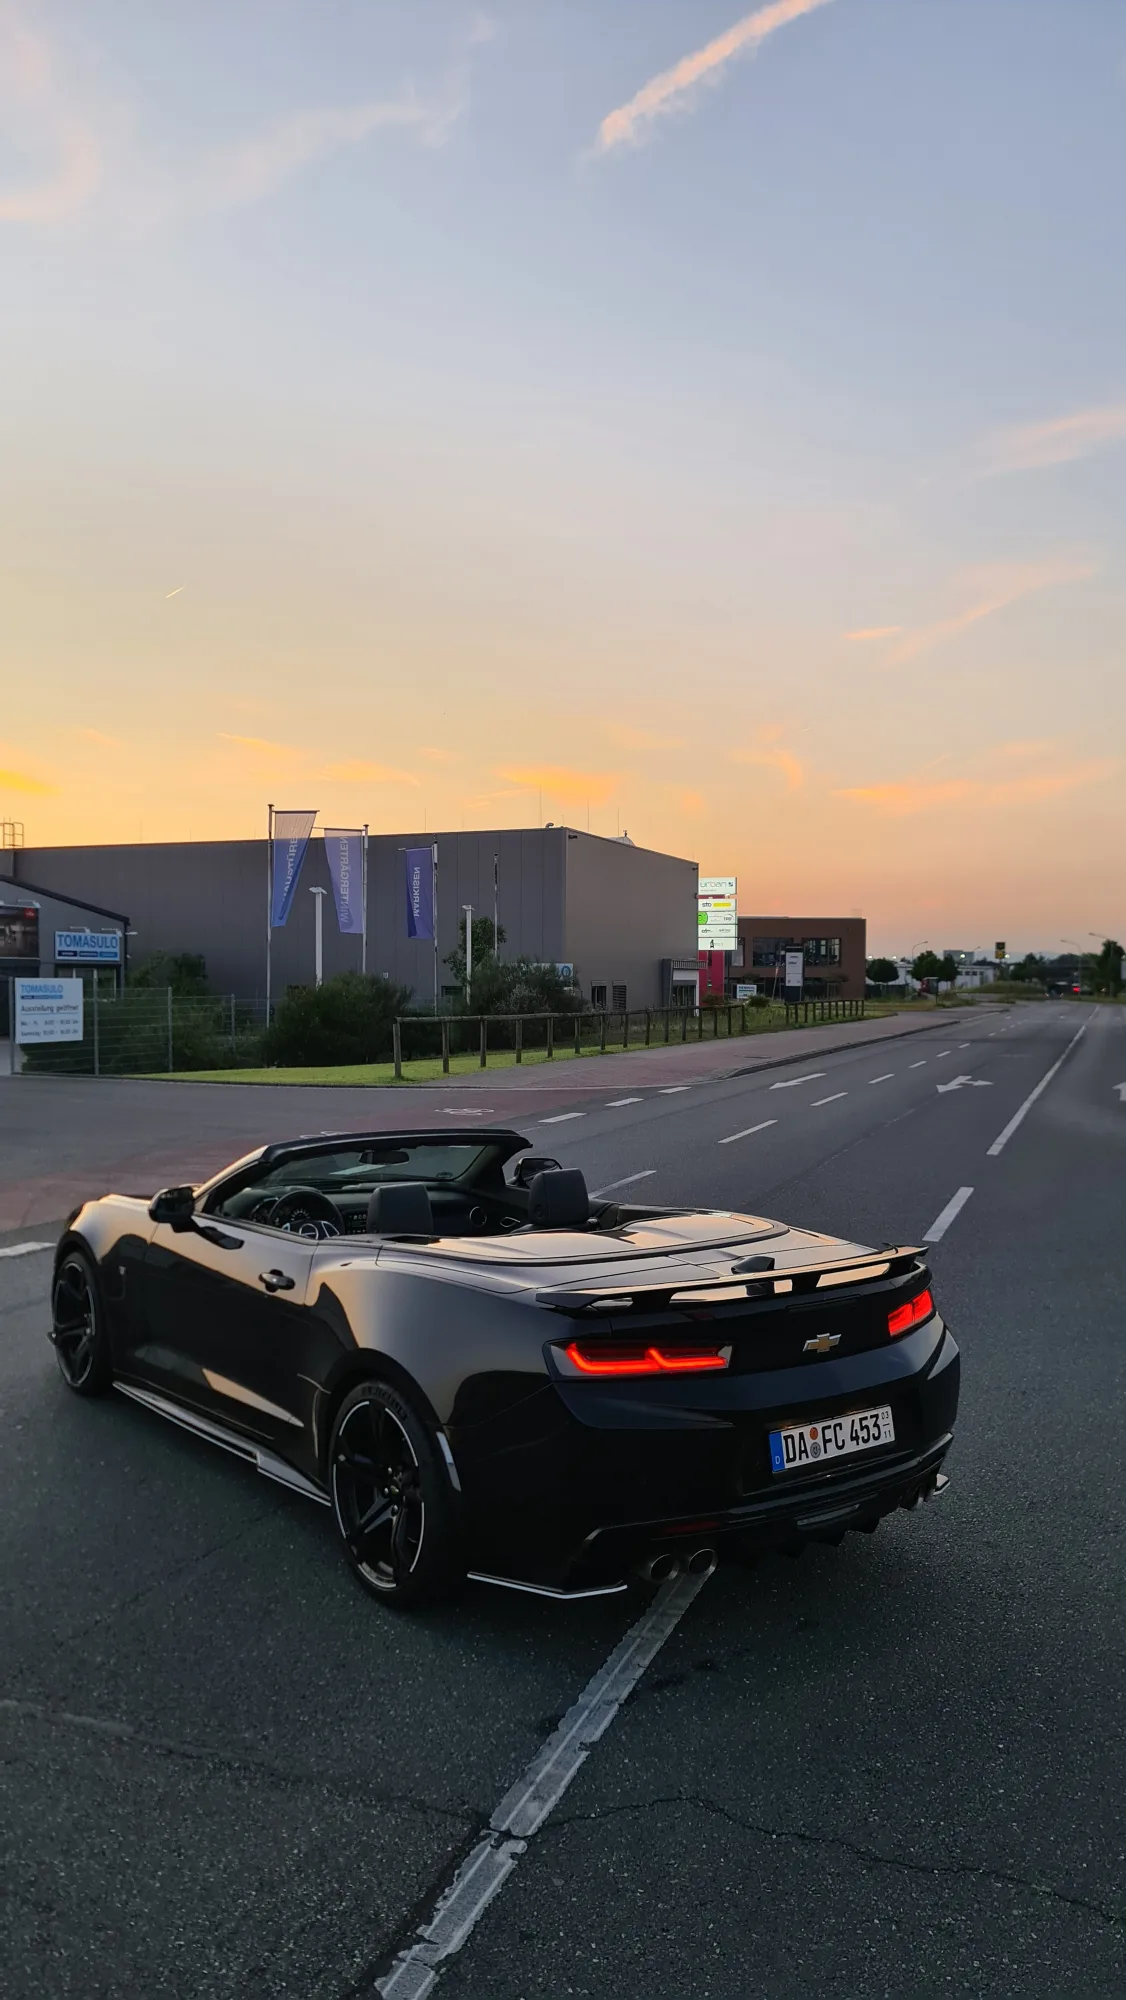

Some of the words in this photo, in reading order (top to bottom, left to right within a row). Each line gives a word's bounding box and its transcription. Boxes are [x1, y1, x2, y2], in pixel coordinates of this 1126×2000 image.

[58, 934, 118, 948] TOMASULO
[21, 984, 63, 993] TOMASULO
[881, 1411, 889, 1420] 03
[783, 1431, 809, 1464] DA
[821, 1422, 845, 1454] FC
[850, 1413, 881, 1446] 453
[775, 1456, 780, 1464] D
